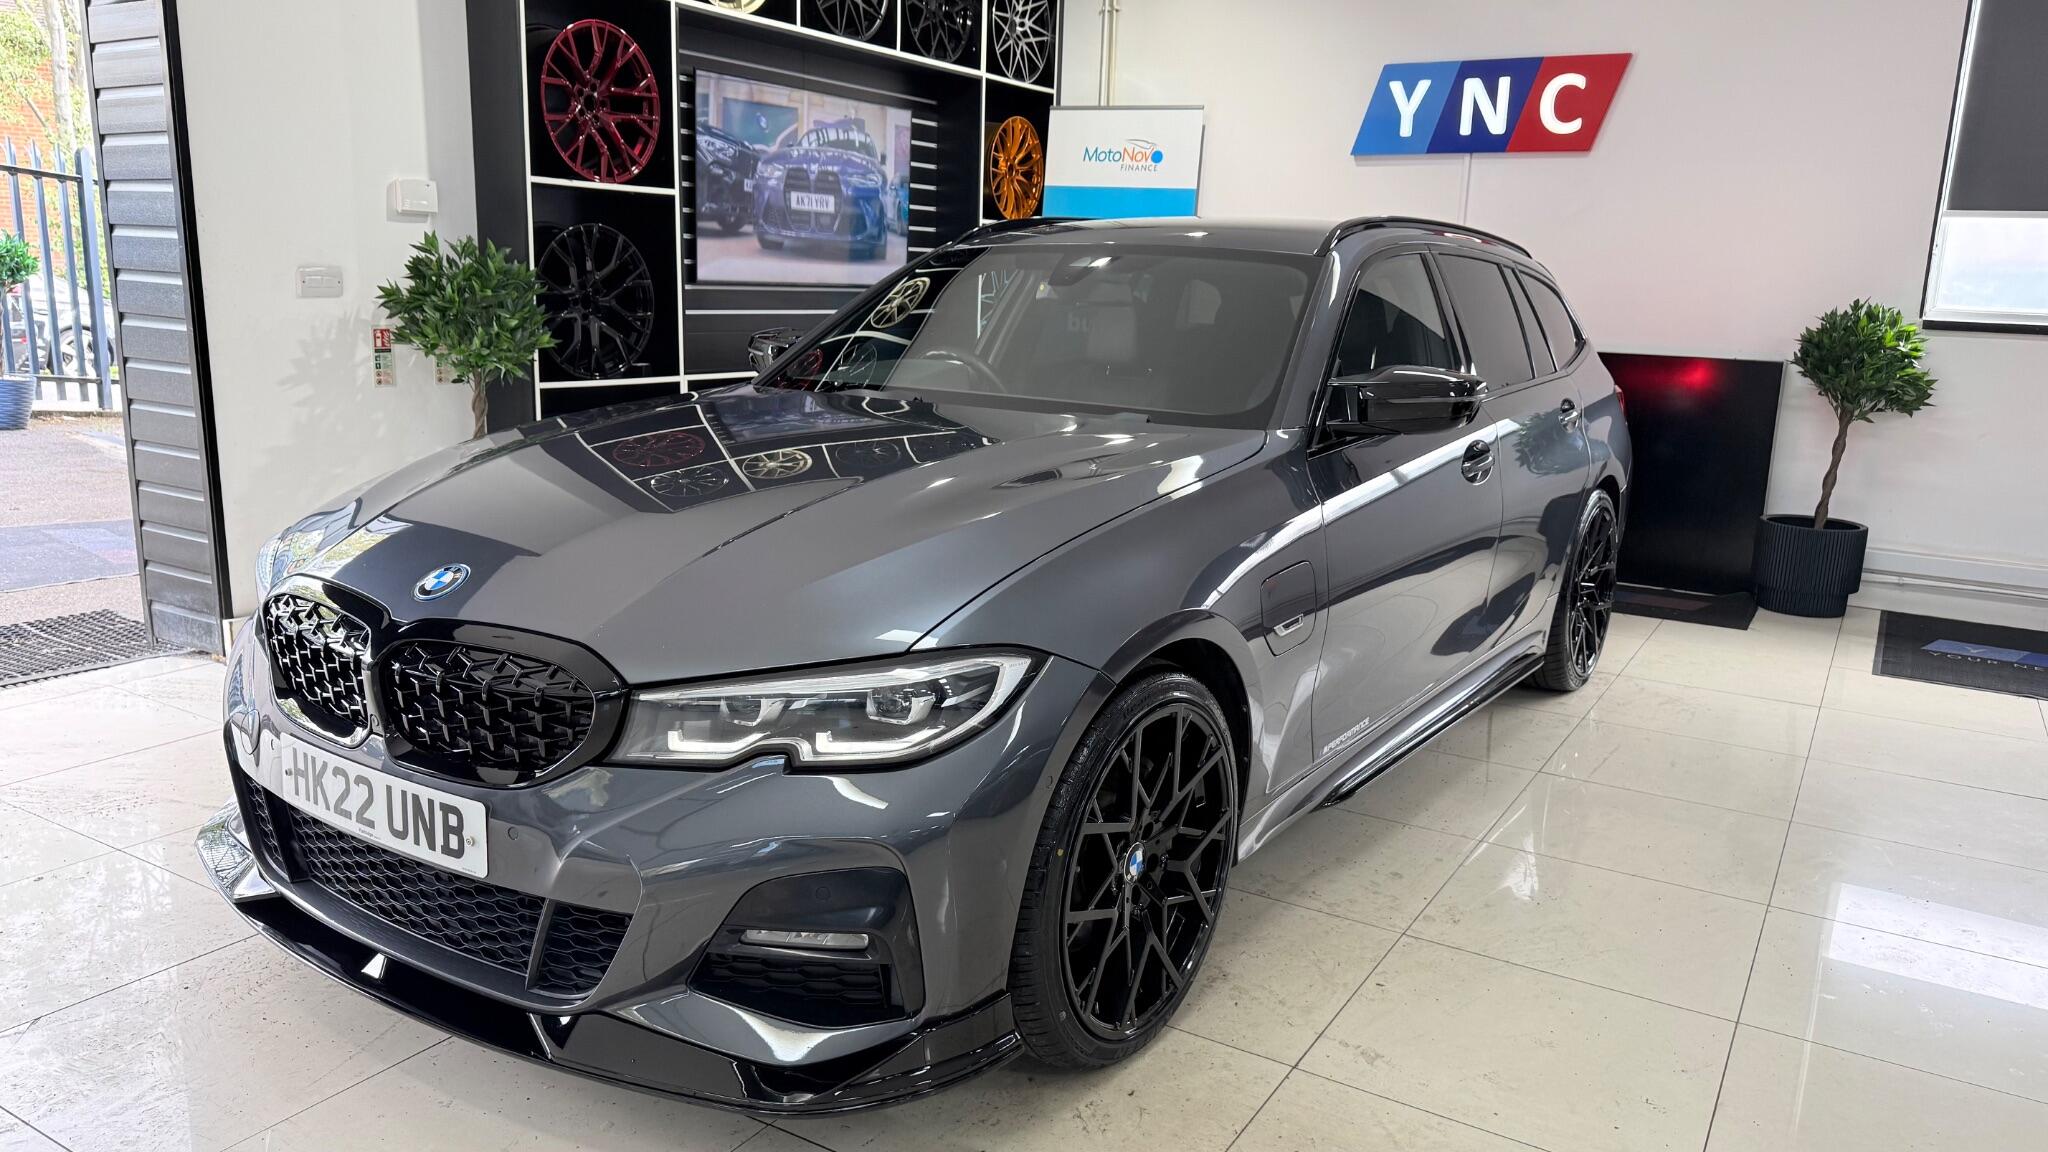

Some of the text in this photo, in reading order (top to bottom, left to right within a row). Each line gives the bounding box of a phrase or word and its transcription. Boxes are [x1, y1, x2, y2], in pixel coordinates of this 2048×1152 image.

[1388, 72, 1587, 138] YNC
[1083, 146, 1163, 164] MotoNovo
[1120, 164, 1158, 172] FINANCE
[1928, 651, 2000, 665] YOUR
[292, 747, 465, 859] HK22 UNB
